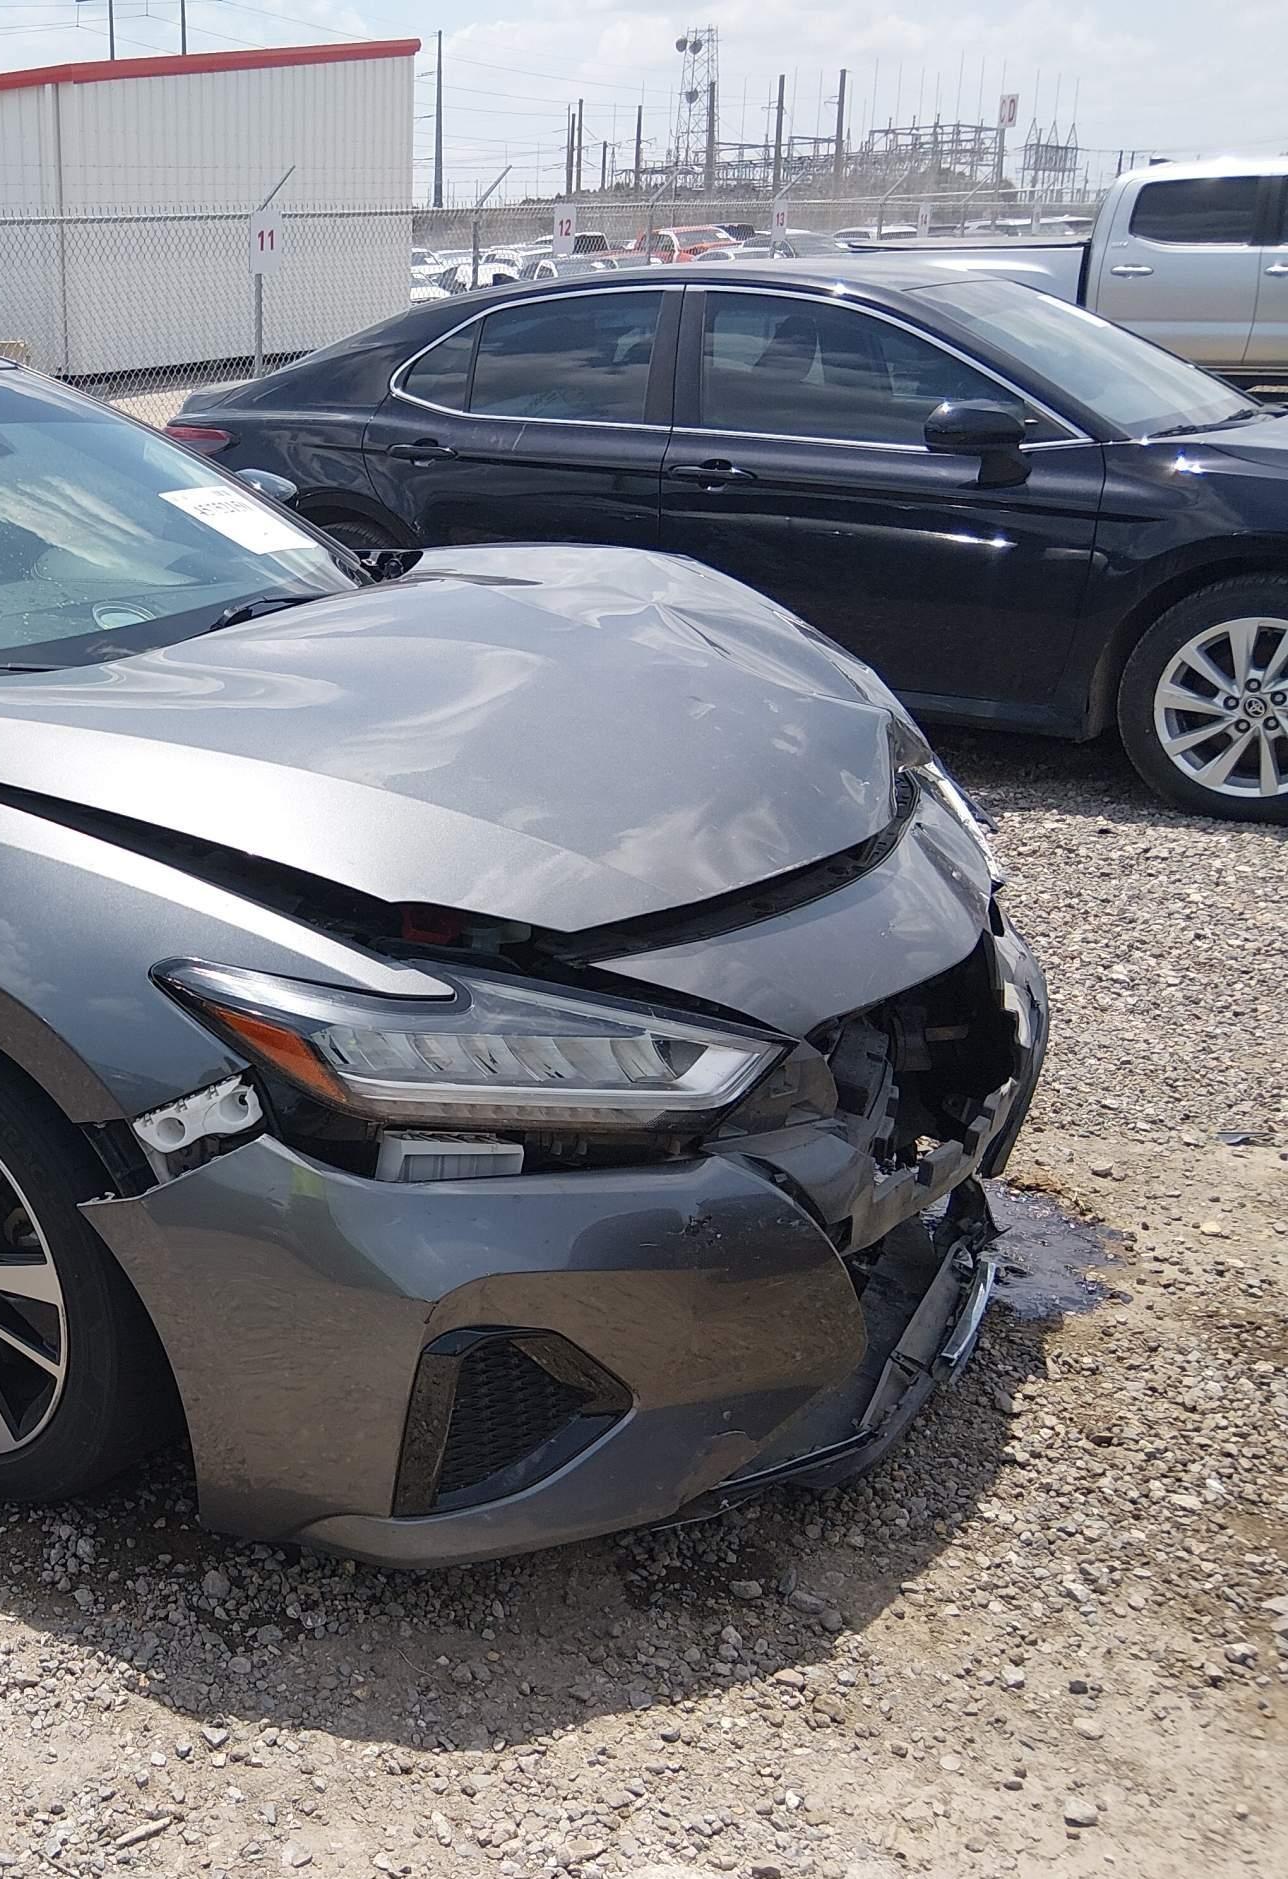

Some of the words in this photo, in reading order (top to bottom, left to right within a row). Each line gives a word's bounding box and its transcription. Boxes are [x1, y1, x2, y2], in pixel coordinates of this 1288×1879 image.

[559, 219, 572, 237] 12
[776, 212, 785, 226] 13
[257, 229, 274, 251] 11
